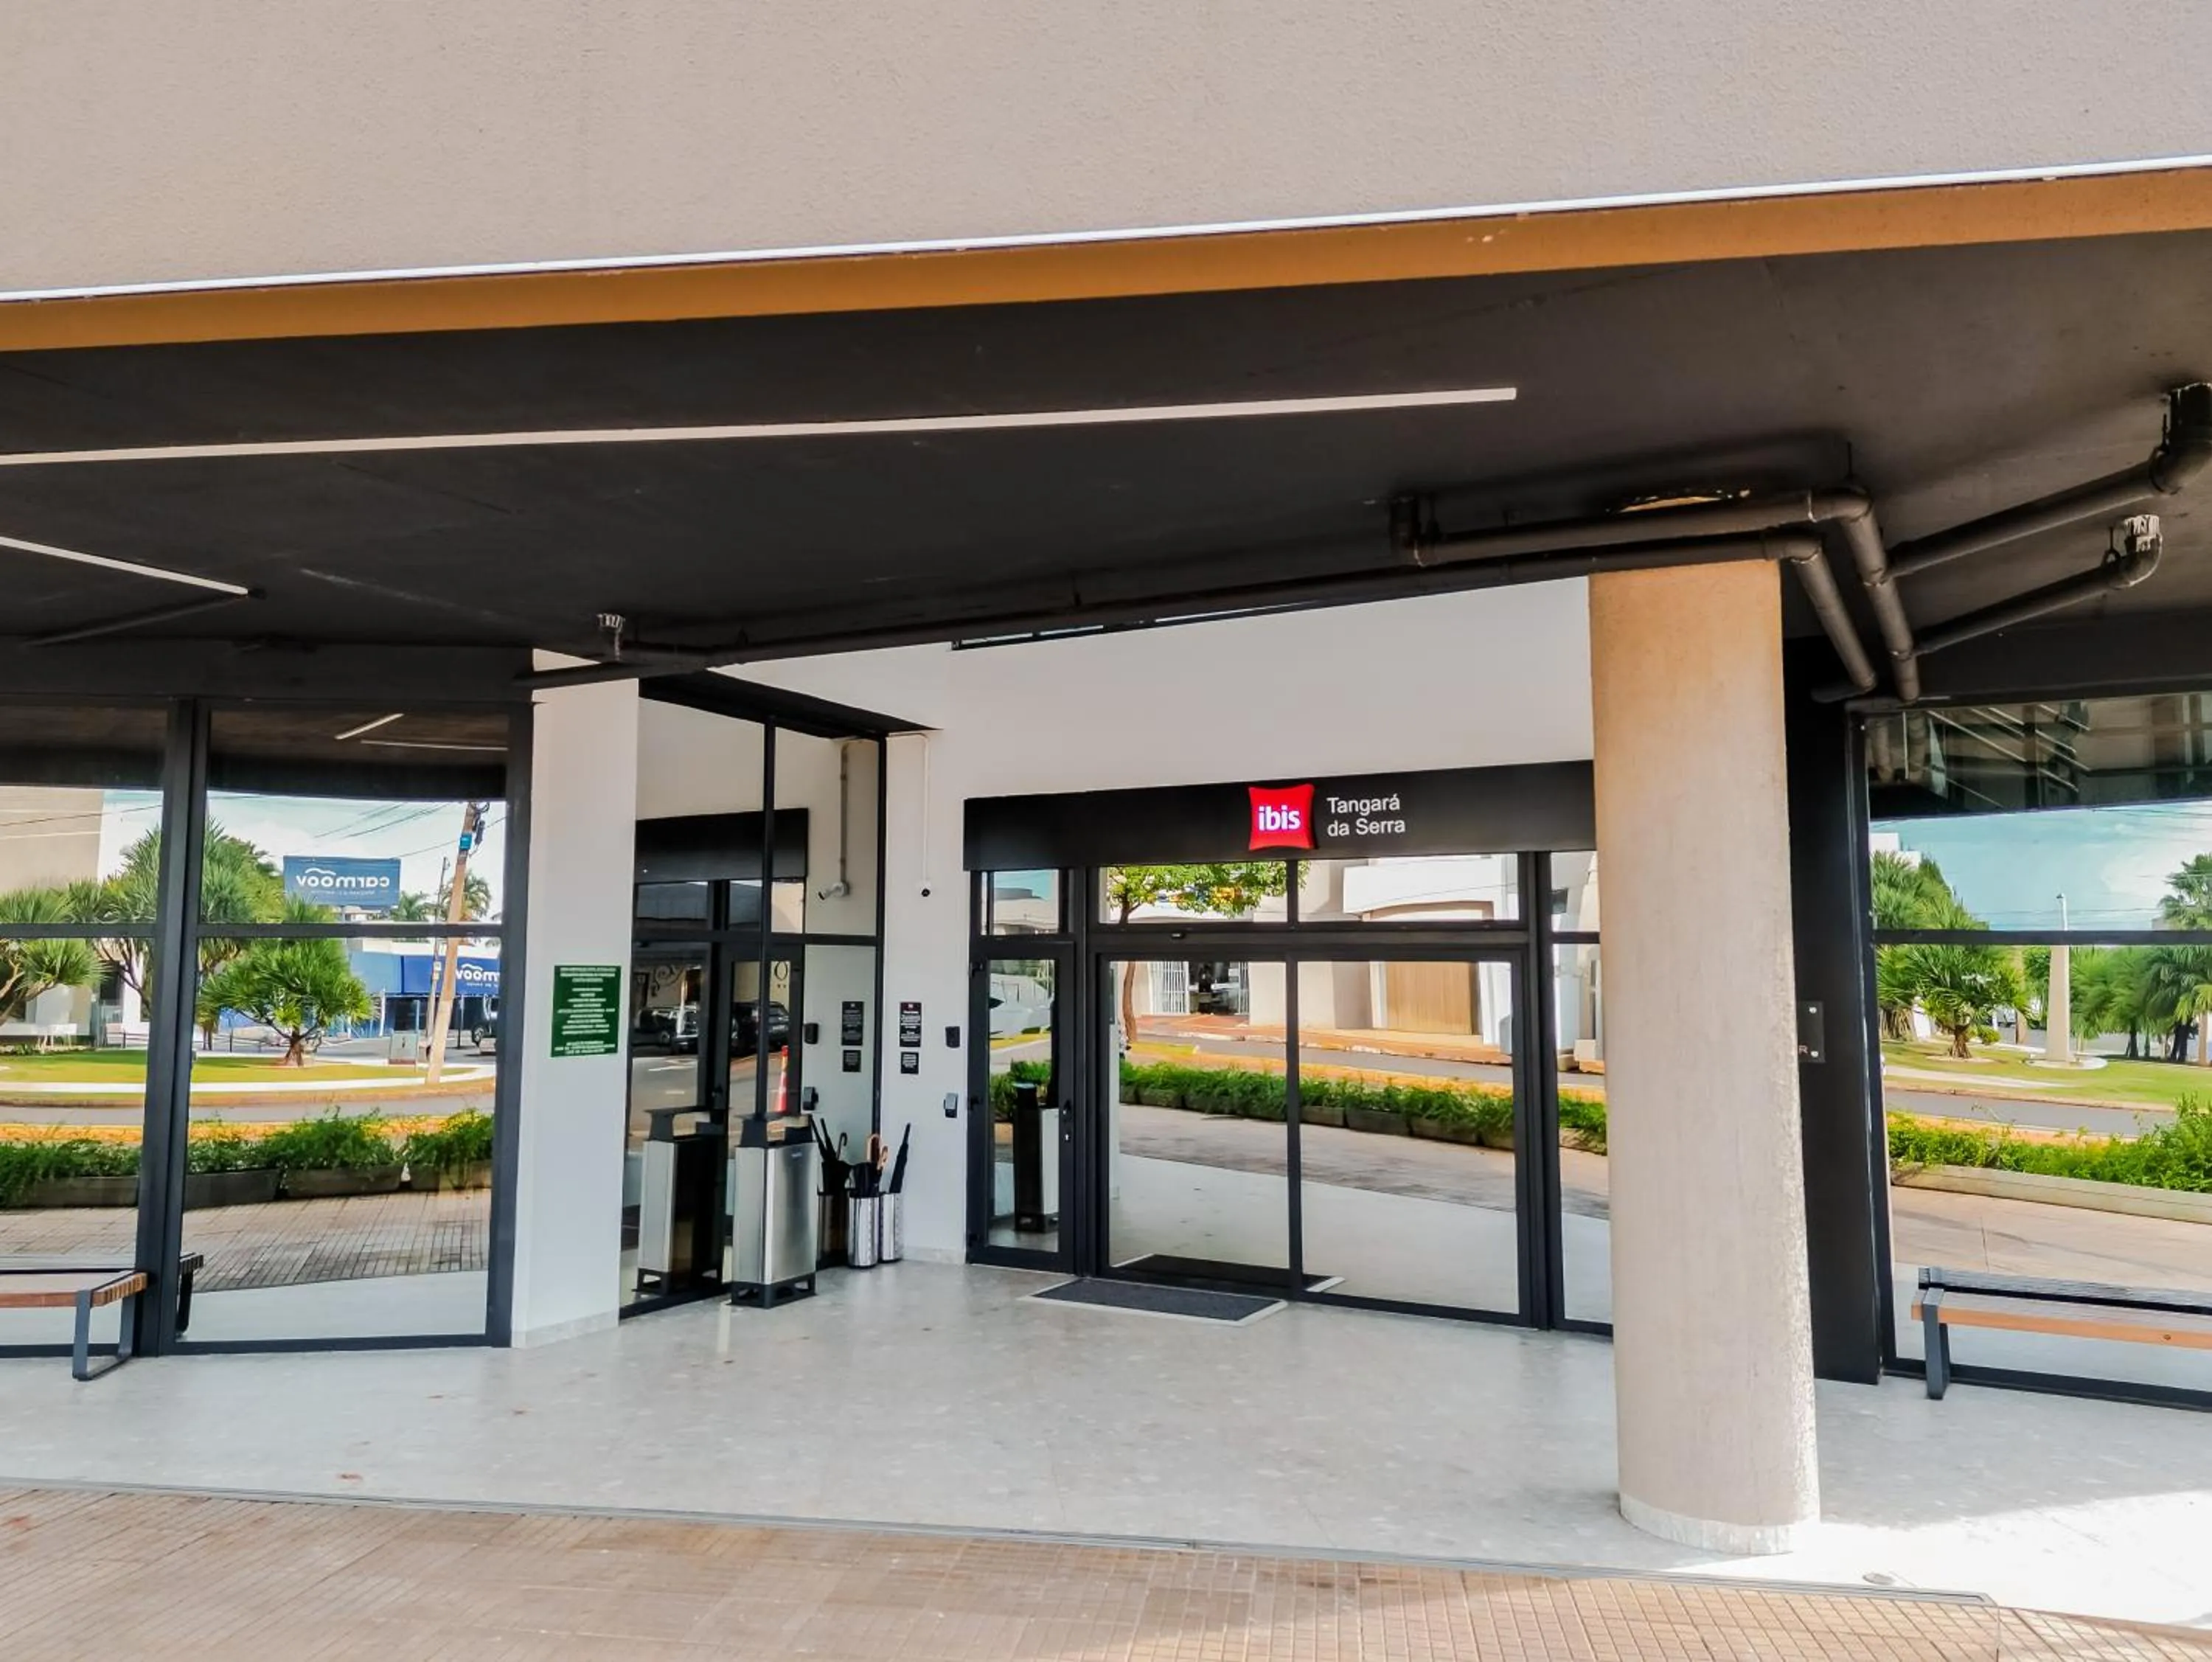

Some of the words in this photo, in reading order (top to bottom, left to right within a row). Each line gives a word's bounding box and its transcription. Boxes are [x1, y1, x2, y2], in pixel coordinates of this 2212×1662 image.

[1326, 793, 1400, 816] Tangará
[1258, 804, 1301, 831] ibis
[1326, 820, 1350, 837] da
[1355, 818, 1405, 835] Serra
